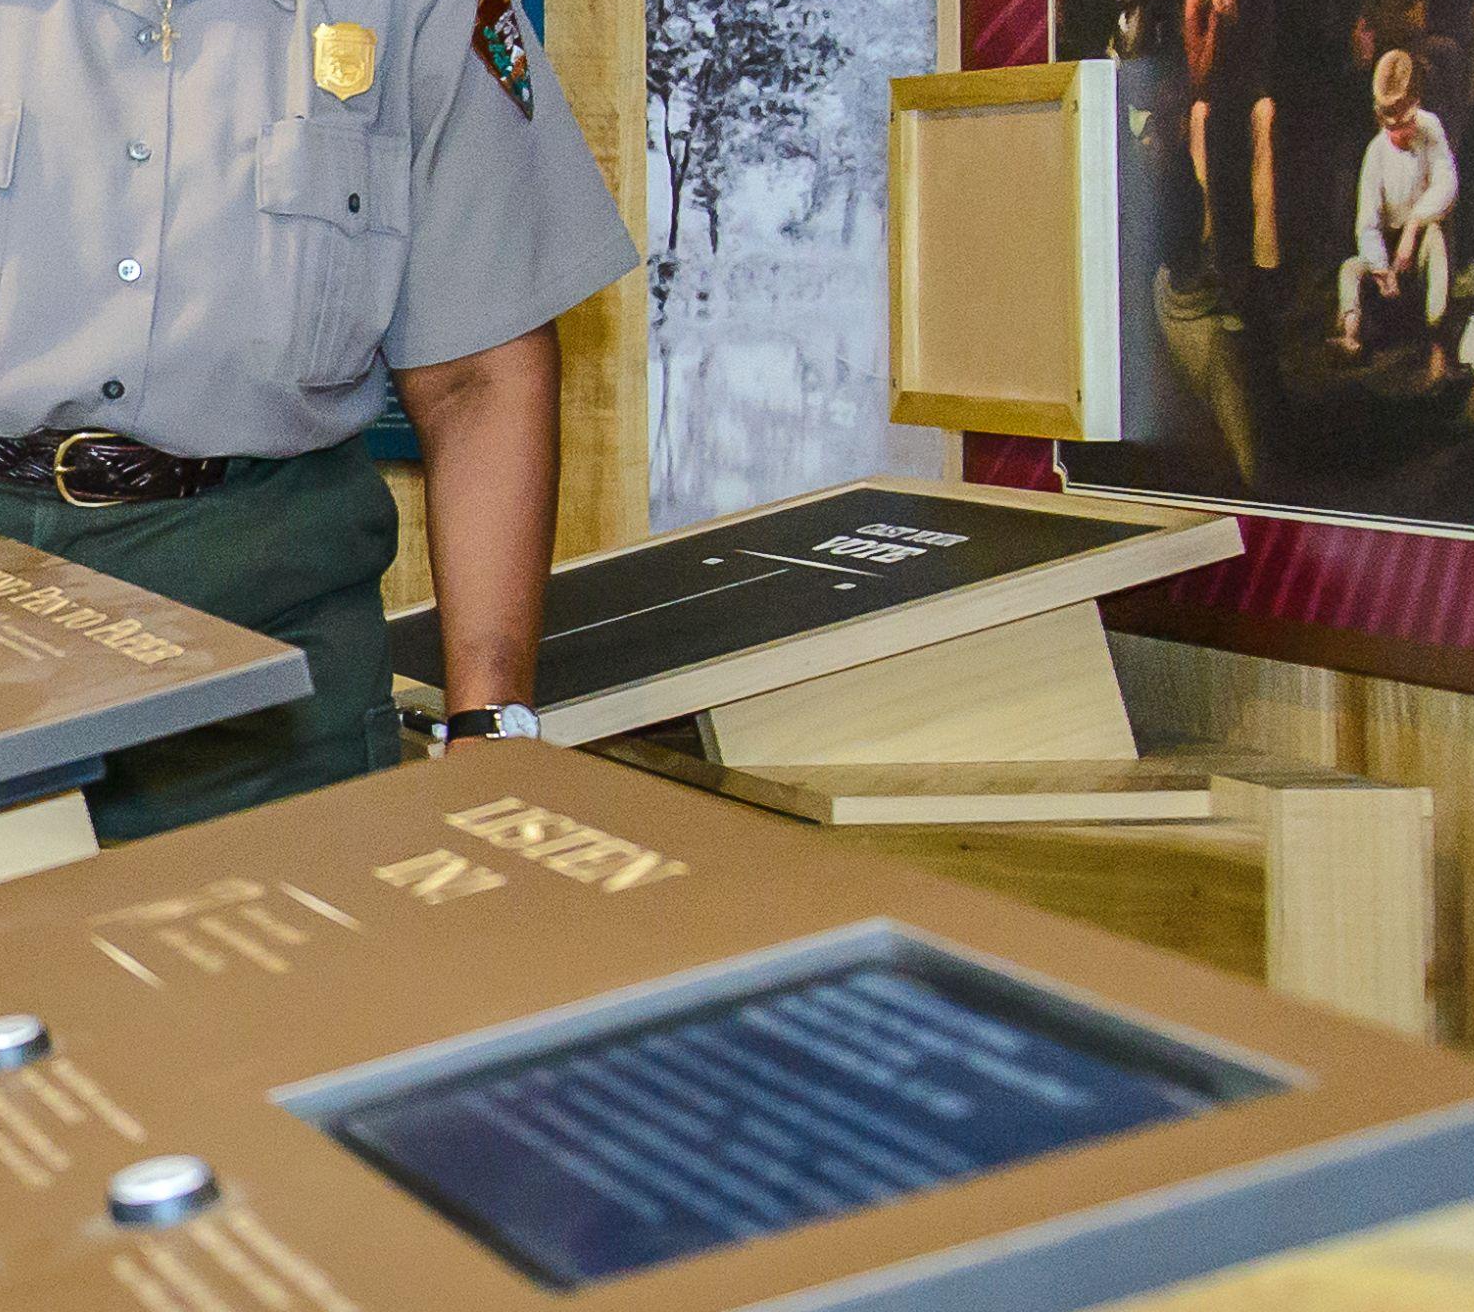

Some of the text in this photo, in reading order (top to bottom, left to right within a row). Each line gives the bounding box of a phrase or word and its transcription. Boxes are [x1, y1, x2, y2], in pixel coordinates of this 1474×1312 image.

[812, 535, 928, 564] VOTE
[9, 586, 80, 616] PEN
[53, 607, 108, 630] TO
[84, 618, 185, 664] PAPER
[373, 847, 508, 906] IN
[444, 796, 690, 893] LISTEN
